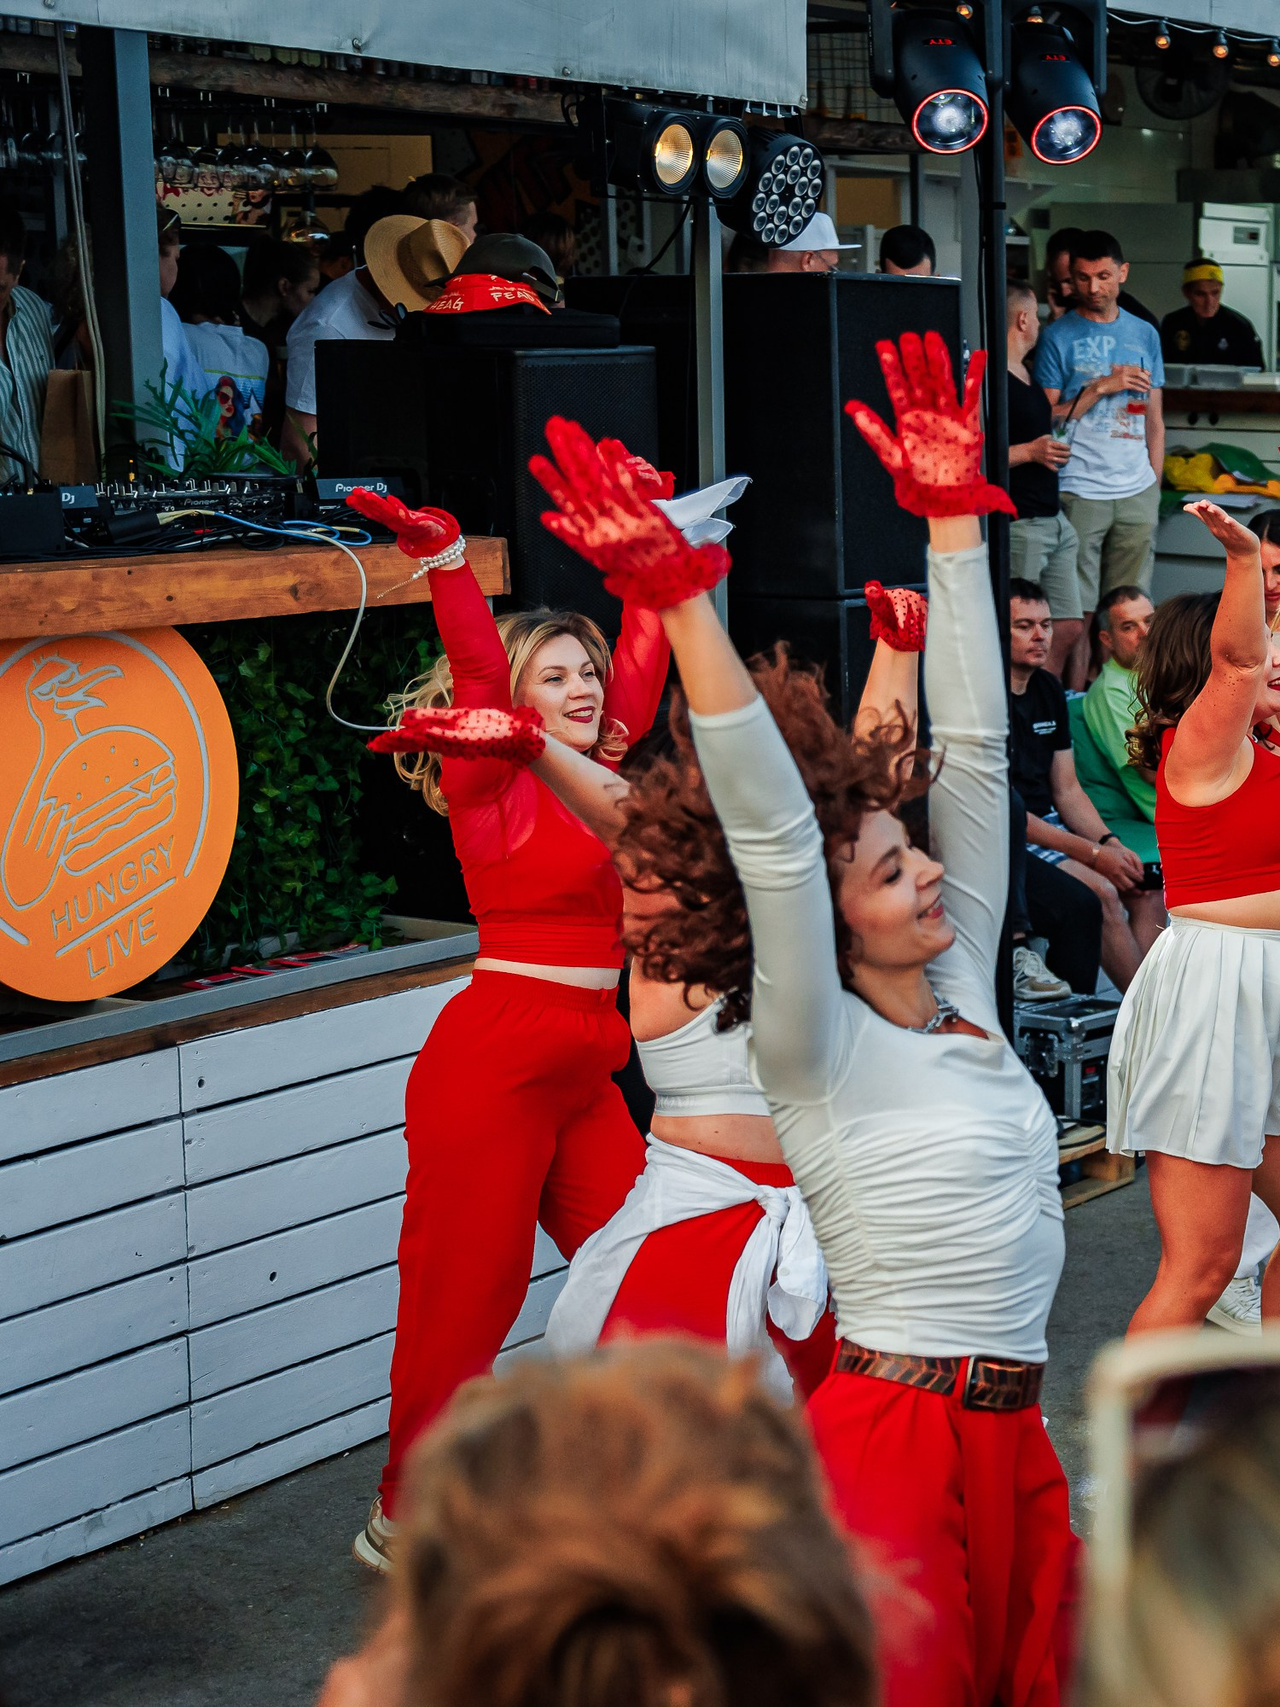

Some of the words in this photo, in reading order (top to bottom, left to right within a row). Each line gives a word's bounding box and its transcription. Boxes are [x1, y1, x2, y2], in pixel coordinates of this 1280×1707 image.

[1073, 335, 1117, 360] EXP
[335, 483, 375, 493] Pioer
[51, 835, 174, 940] HUNGRY
[86, 907, 158, 980] LIVE
